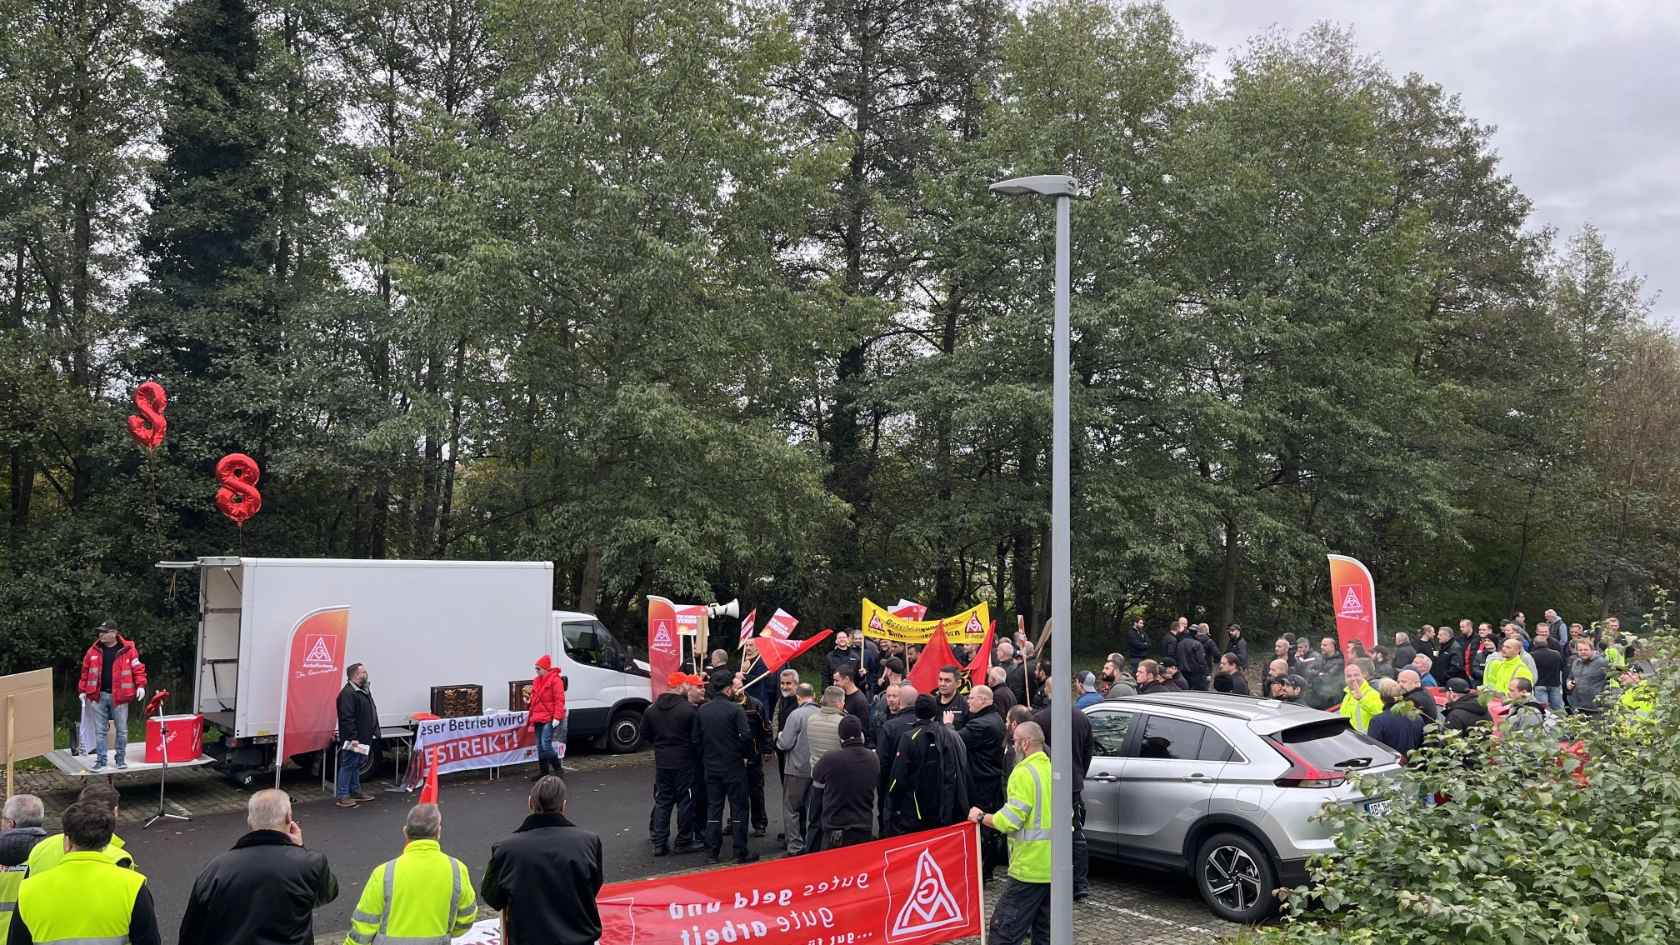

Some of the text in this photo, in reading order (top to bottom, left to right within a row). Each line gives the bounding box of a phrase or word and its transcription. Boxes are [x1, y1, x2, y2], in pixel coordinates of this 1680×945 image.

[215, 453, 262, 522] 8
[308, 638, 330, 661] IGM
[421, 712, 525, 736] eser Betrieb wird
[424, 730, 519, 766] ESTREIKT!
